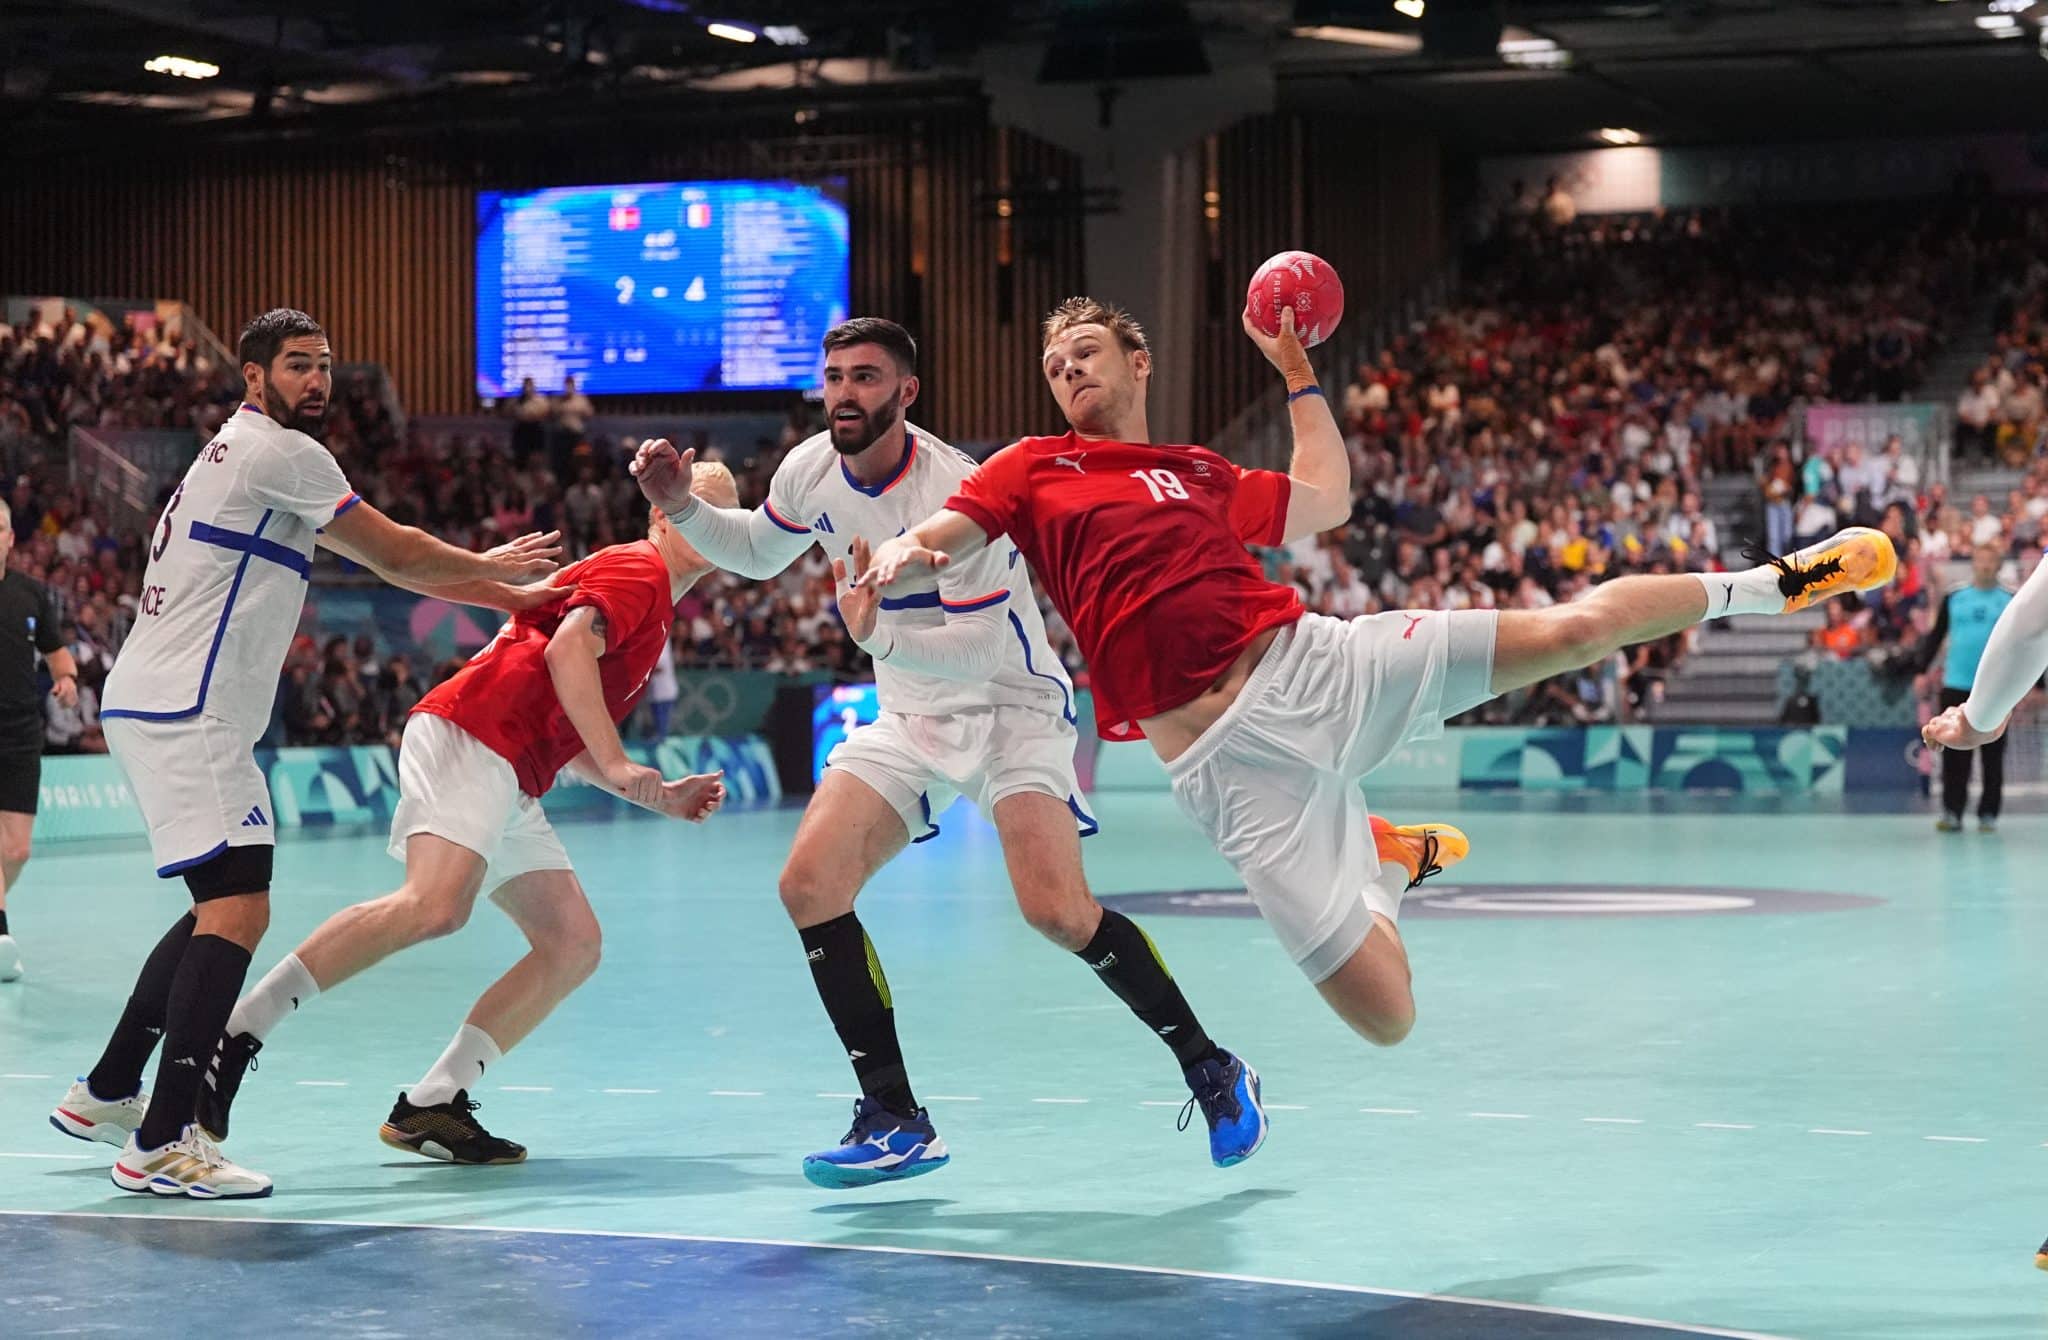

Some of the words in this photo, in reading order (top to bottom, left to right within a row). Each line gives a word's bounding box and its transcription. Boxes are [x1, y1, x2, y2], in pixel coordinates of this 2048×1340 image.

[684, 276, 706, 301] 4
[1129, 468, 1190, 503] 19
[40, 784, 102, 809] PARIS
